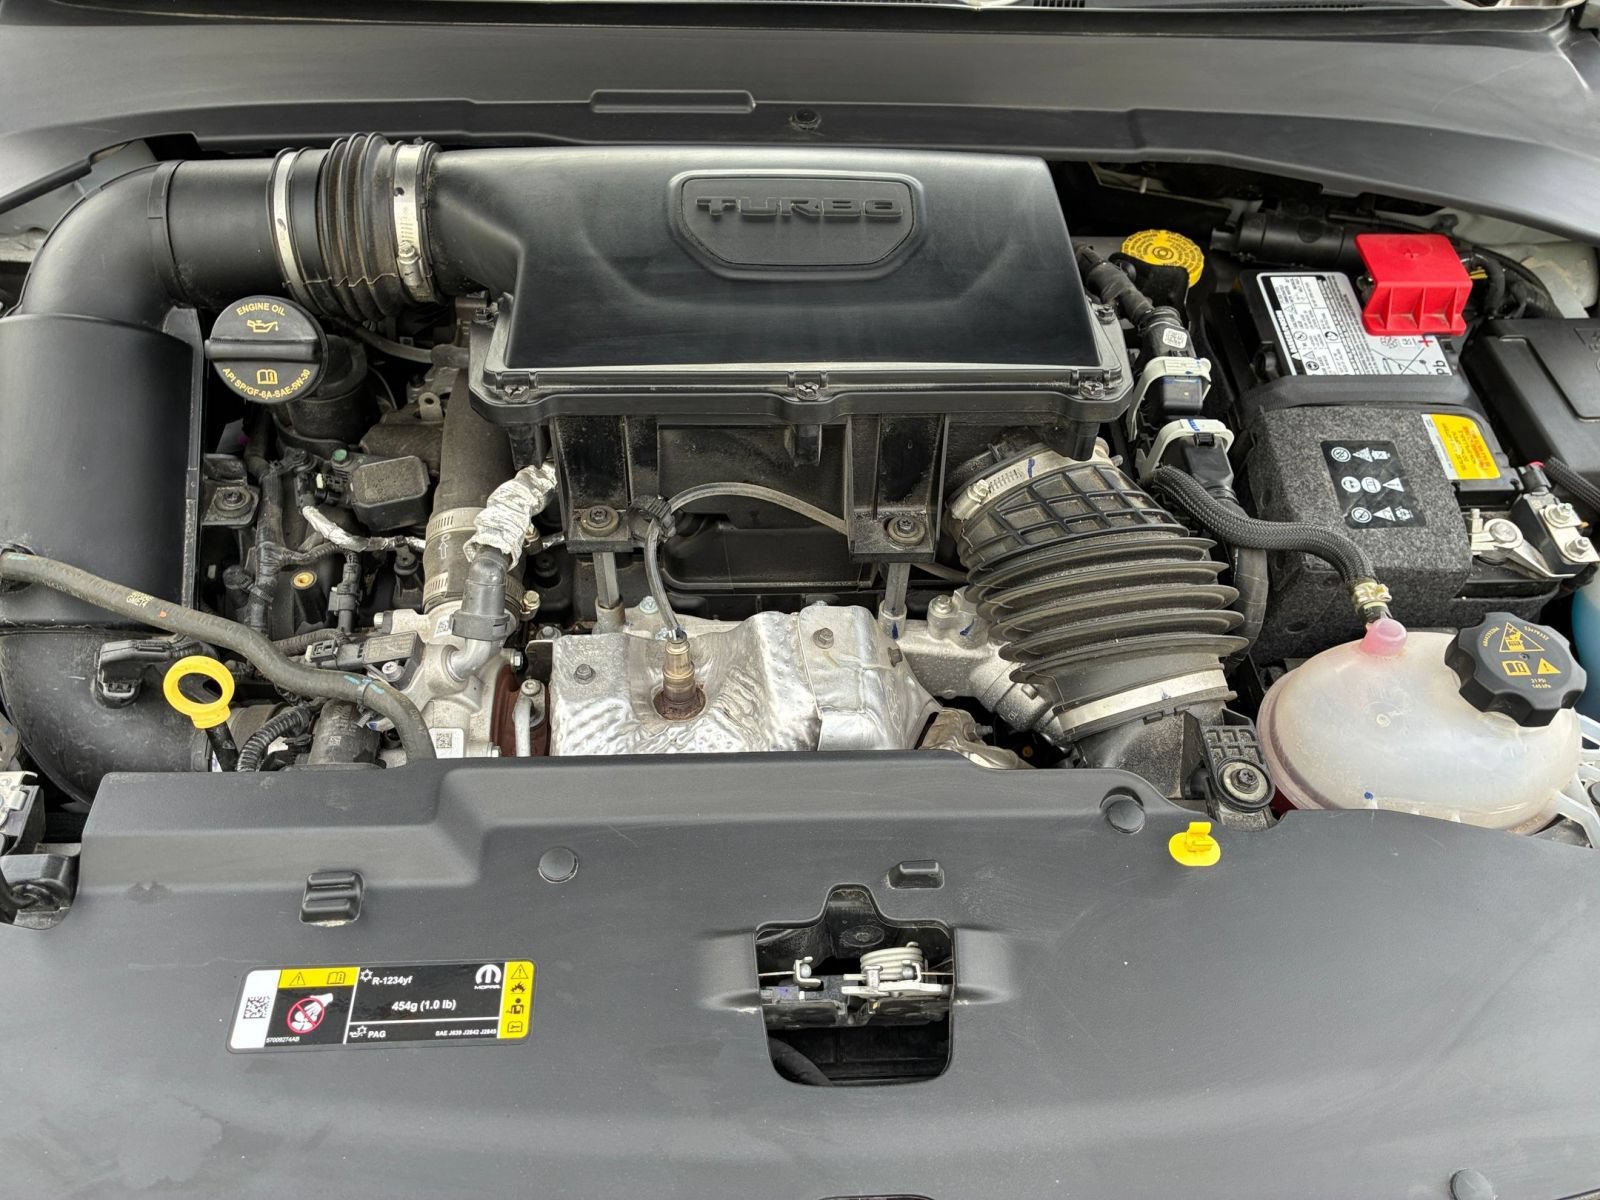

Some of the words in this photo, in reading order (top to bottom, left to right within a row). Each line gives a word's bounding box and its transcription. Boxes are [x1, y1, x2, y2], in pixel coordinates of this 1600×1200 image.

[696, 196, 903, 218] TURBO
[236, 302, 270, 316] ENGINE
[271, 304, 286, 317] OIL
[222, 367, 236, 382] API
[371, 975, 413, 986] R-1234yf
[391, 1001, 418, 1012] 454g
[420, 1000, 440, 1012] (1.0
[441, 999, 457, 1011] lb)
[367, 1030, 386, 1038] PAG
